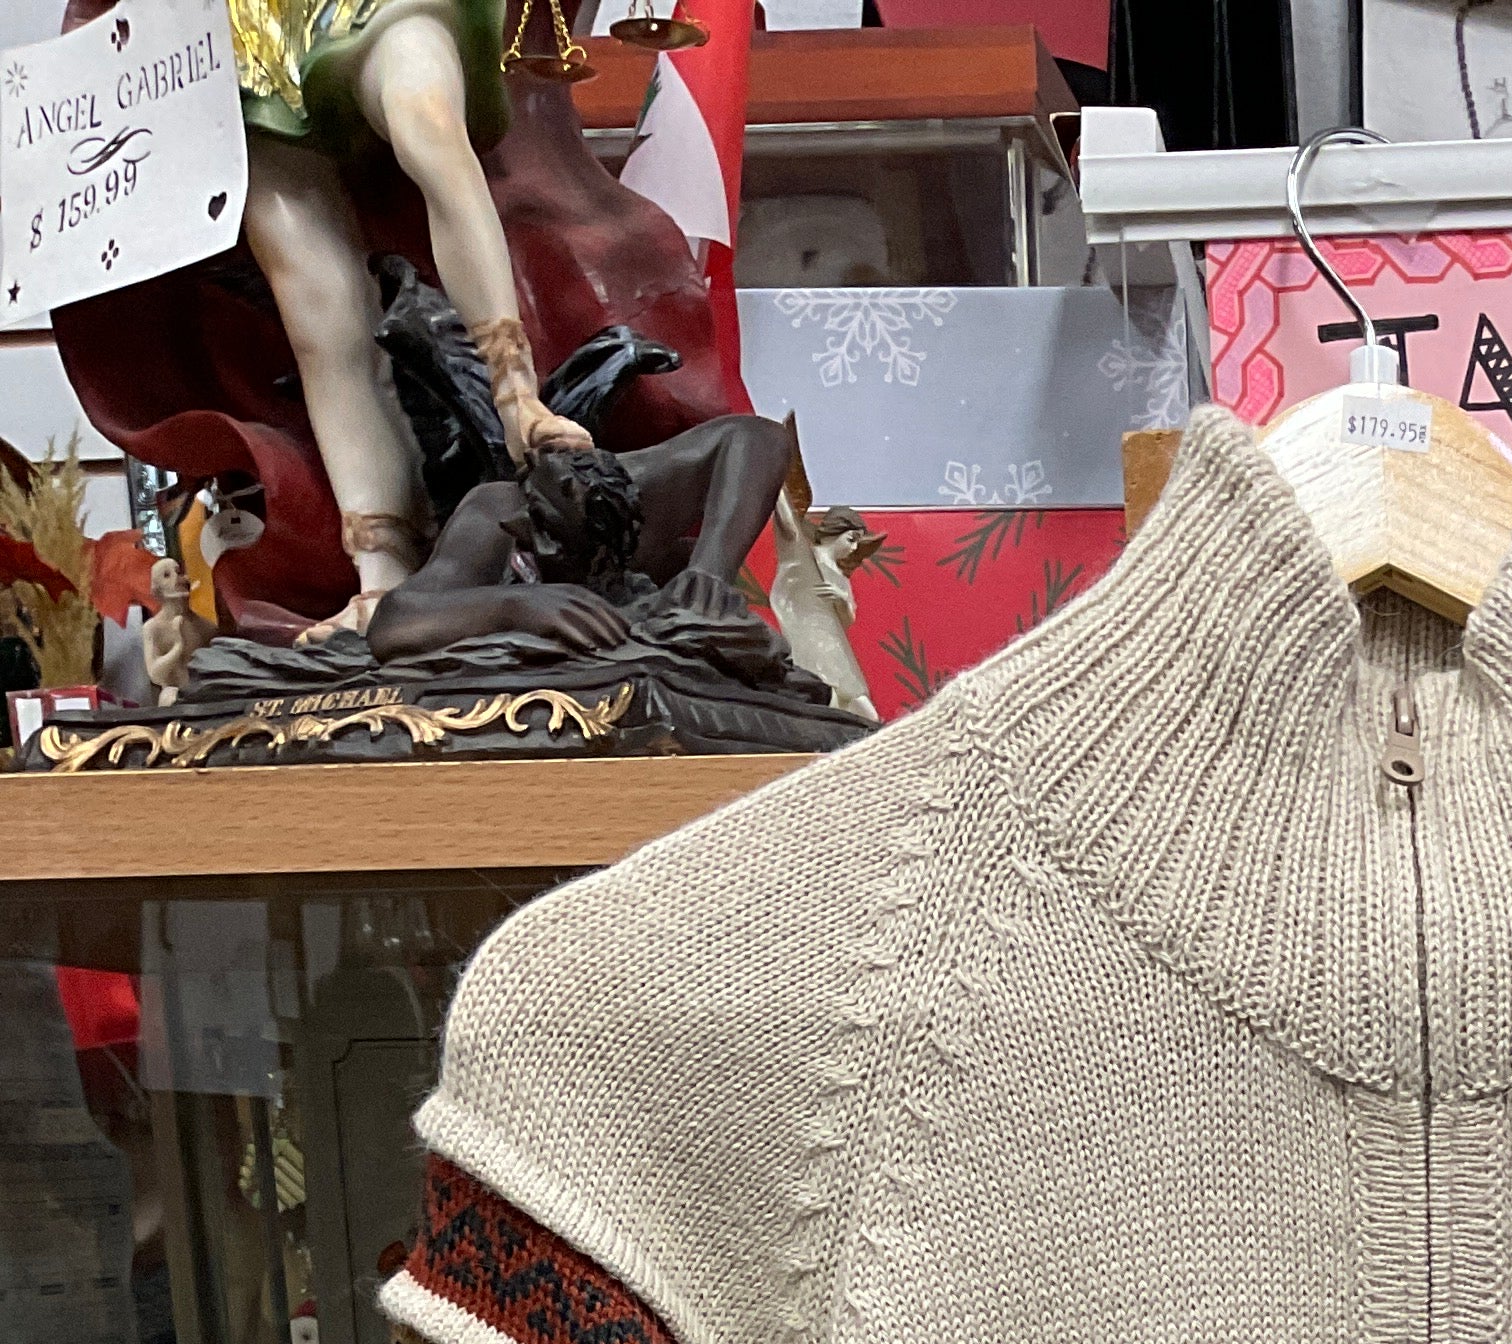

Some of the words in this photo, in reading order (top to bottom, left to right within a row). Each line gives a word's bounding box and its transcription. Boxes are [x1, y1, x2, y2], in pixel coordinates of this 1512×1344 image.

[16, 93, 103, 149] ANGEL
[116, 31, 222, 110] GABRIEL
[57, 158, 138, 234] 159.99
[1347, 415, 1418, 443] $179.95
[289, 686, 404, 715] MICHAEL
